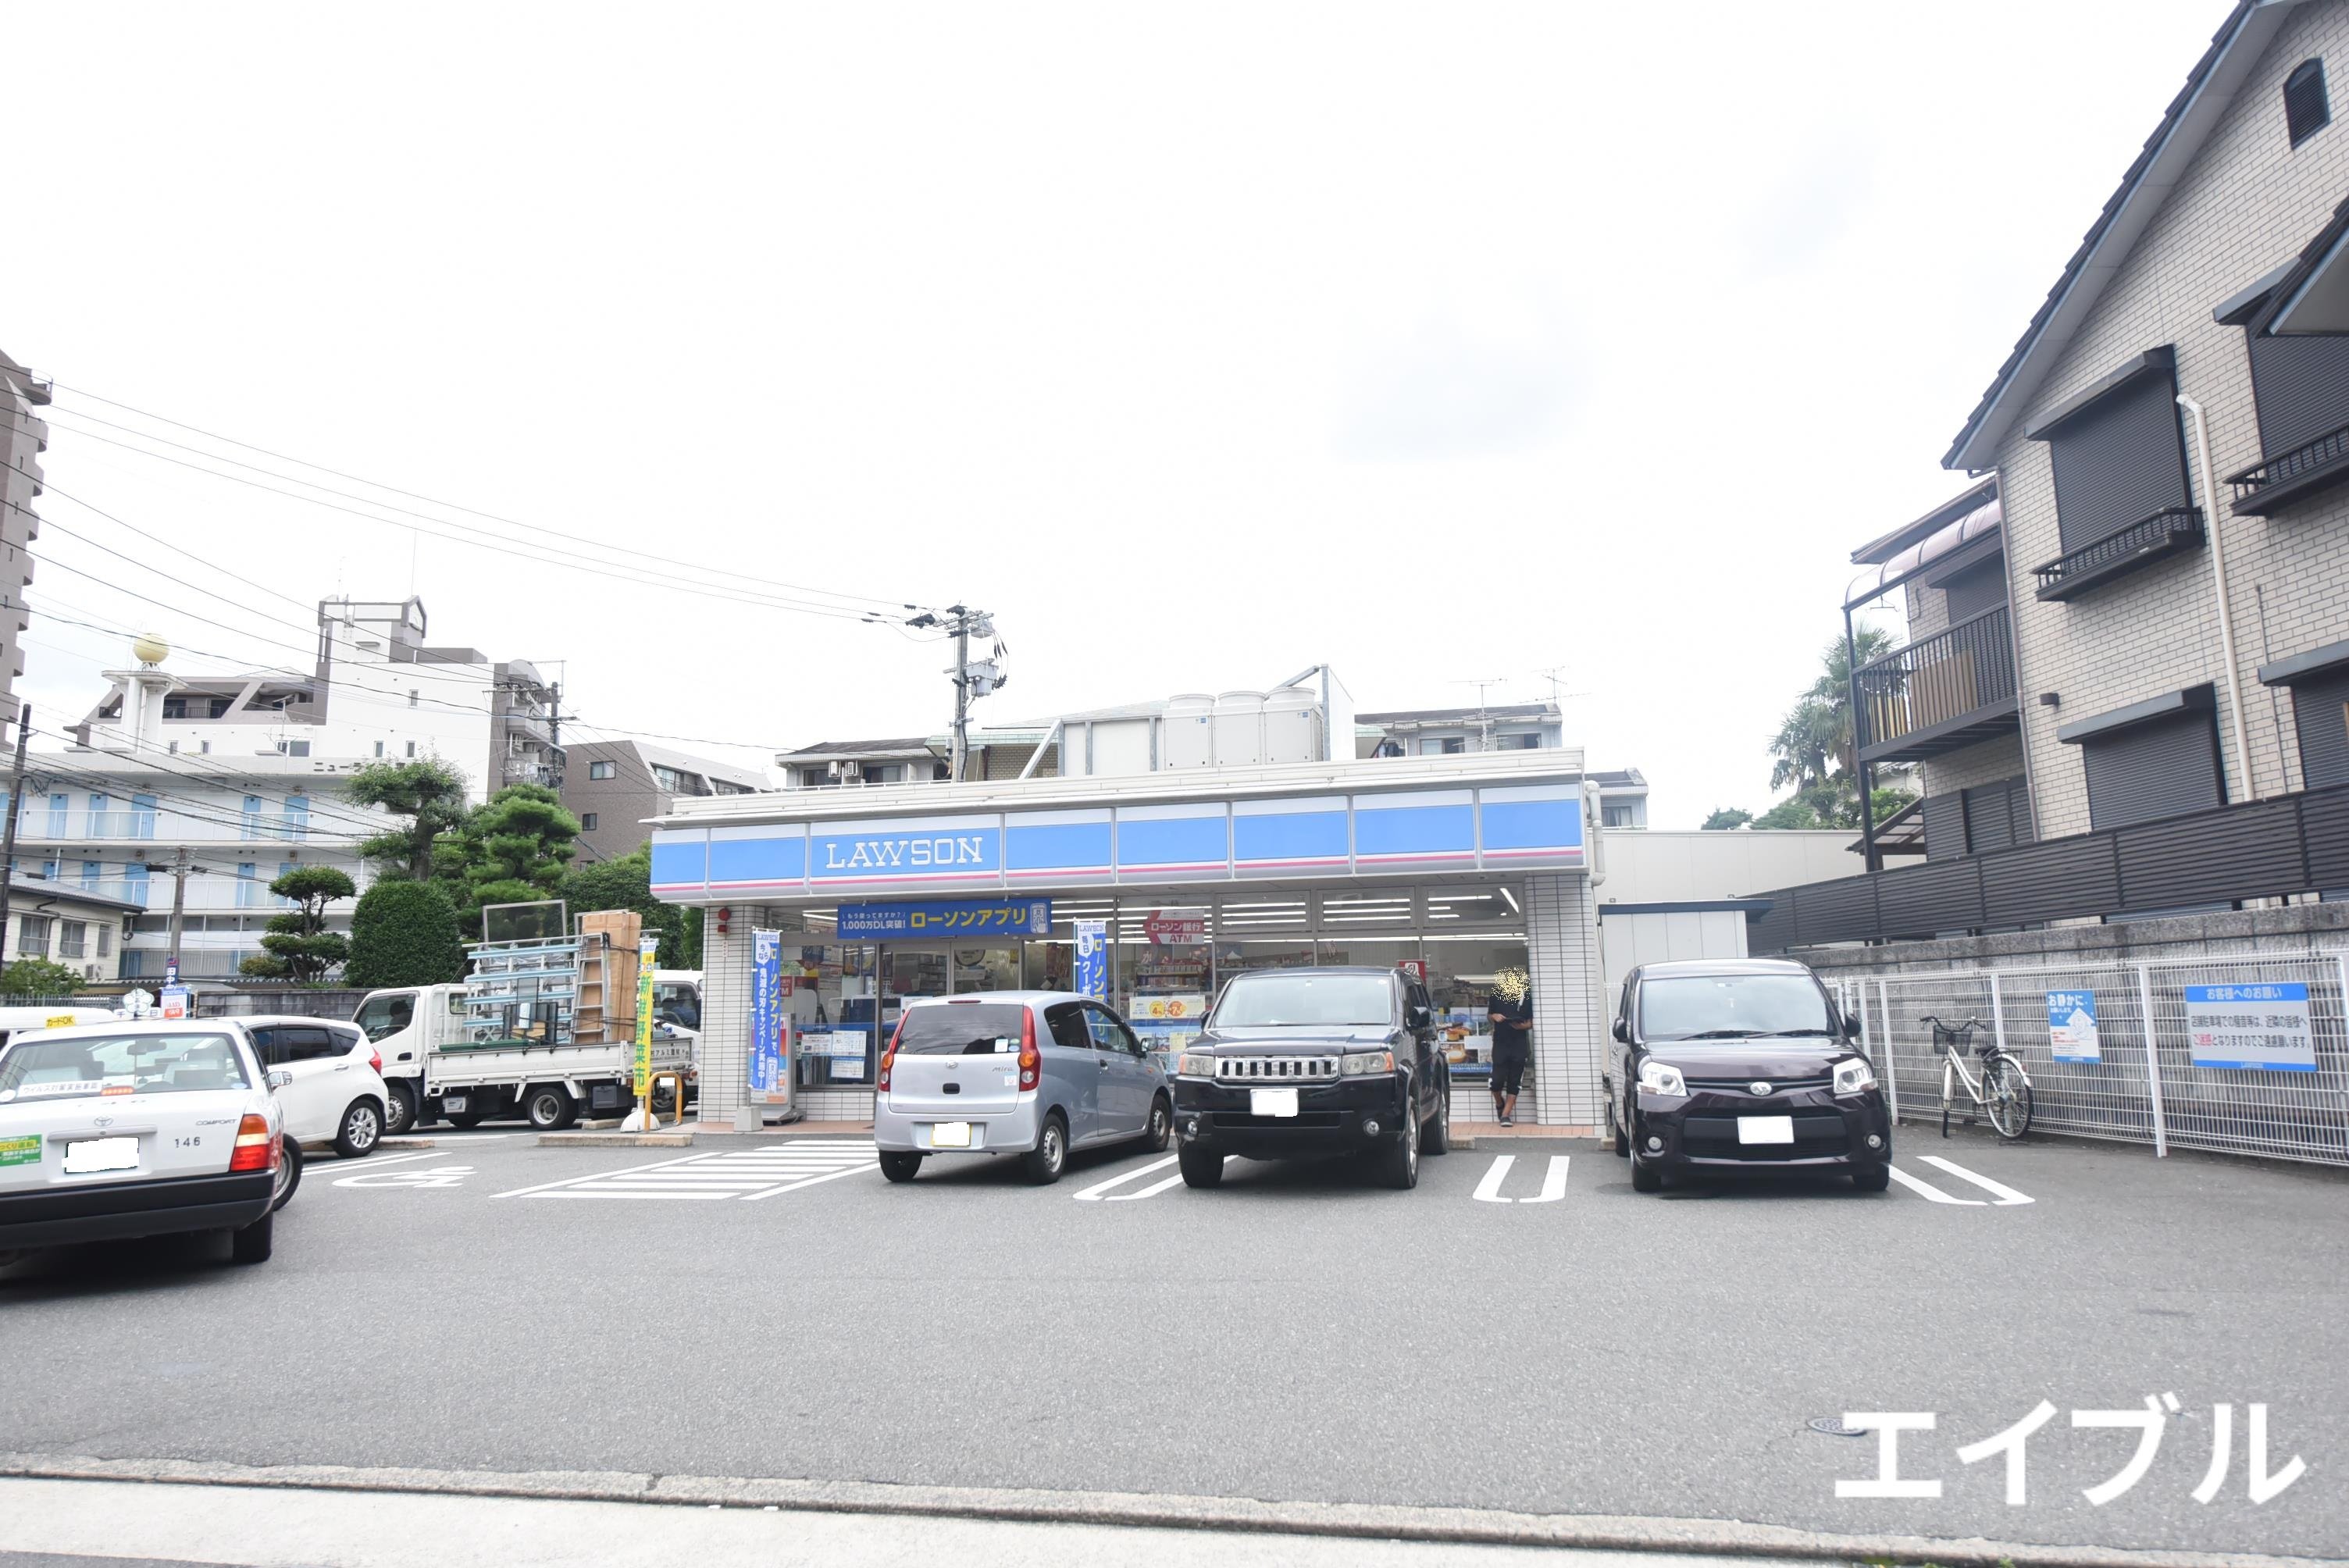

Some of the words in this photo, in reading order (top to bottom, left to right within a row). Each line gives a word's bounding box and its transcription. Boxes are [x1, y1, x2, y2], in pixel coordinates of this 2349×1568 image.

[825, 836, 983, 869] LAWSON
[911, 907, 1027, 928] ローソンアプリ
[1151, 922, 1201, 932] ローソン銀行
[1170, 934, 1192, 943] ATM
[1082, 961, 1092, 996] クーポ
[2206, 986, 2283, 1000] お客様へのお願い
[46, 1016, 74, 1028] カードOK
[635, 975, 651, 1088] 新鮮野菜市
[175, 1137, 201, 1148] 146
